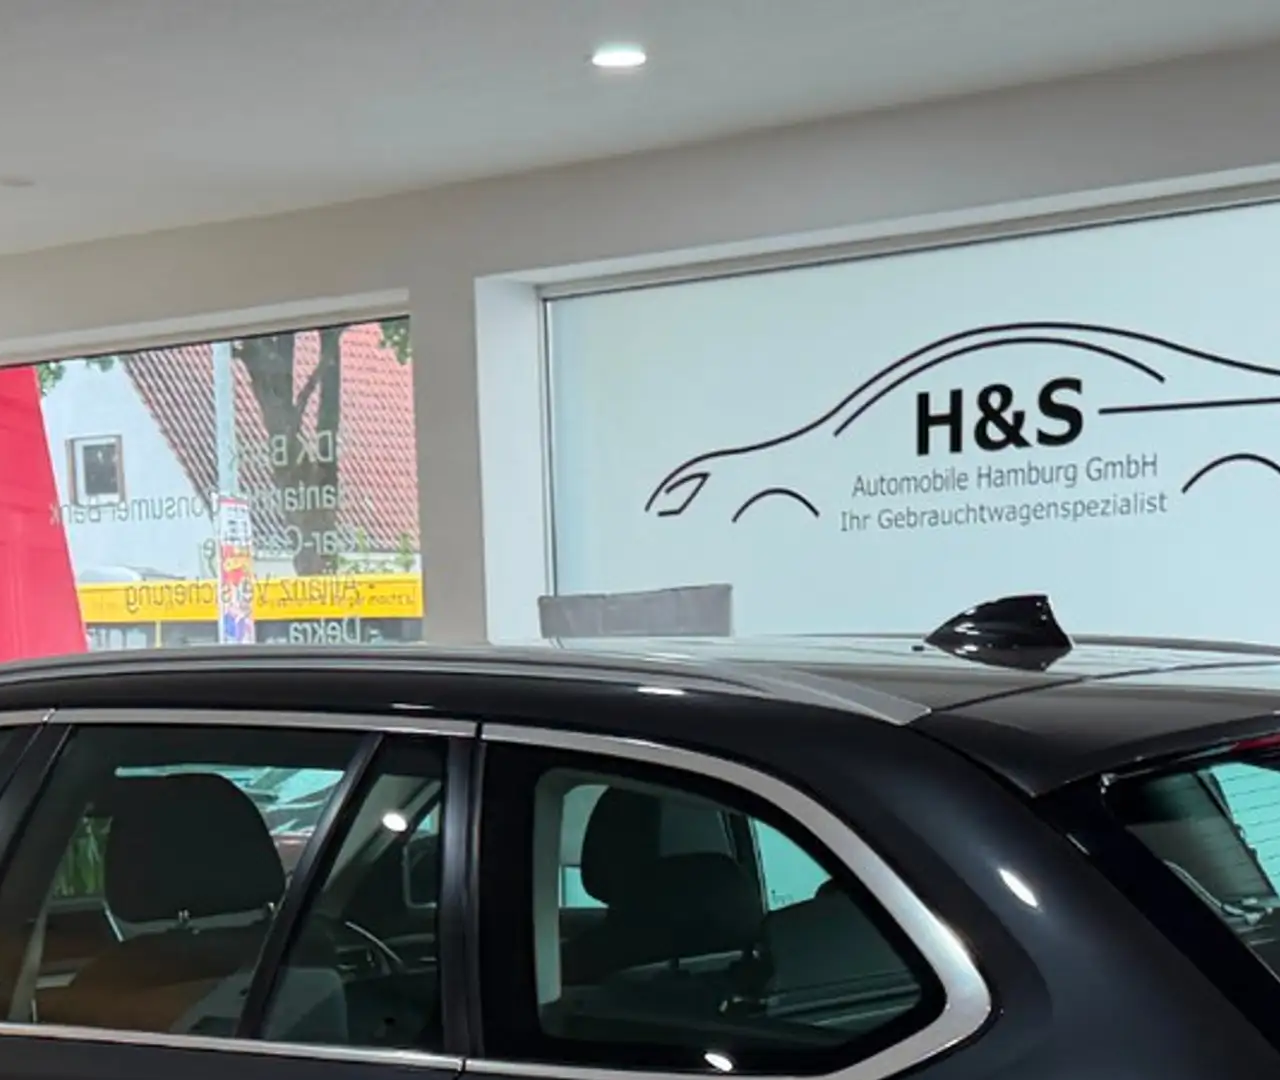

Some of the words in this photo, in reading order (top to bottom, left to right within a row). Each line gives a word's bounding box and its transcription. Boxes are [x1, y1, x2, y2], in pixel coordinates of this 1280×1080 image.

[916, 377, 1084, 456] H&S
[851, 467, 969, 498] Automobile
[976, 459, 1077, 489] Hamburg
[1085, 453, 1158, 482] GmbH
[840, 510, 870, 532] Ihr
[877, 491, 1168, 530] Gebrauchtwagenspezialist
